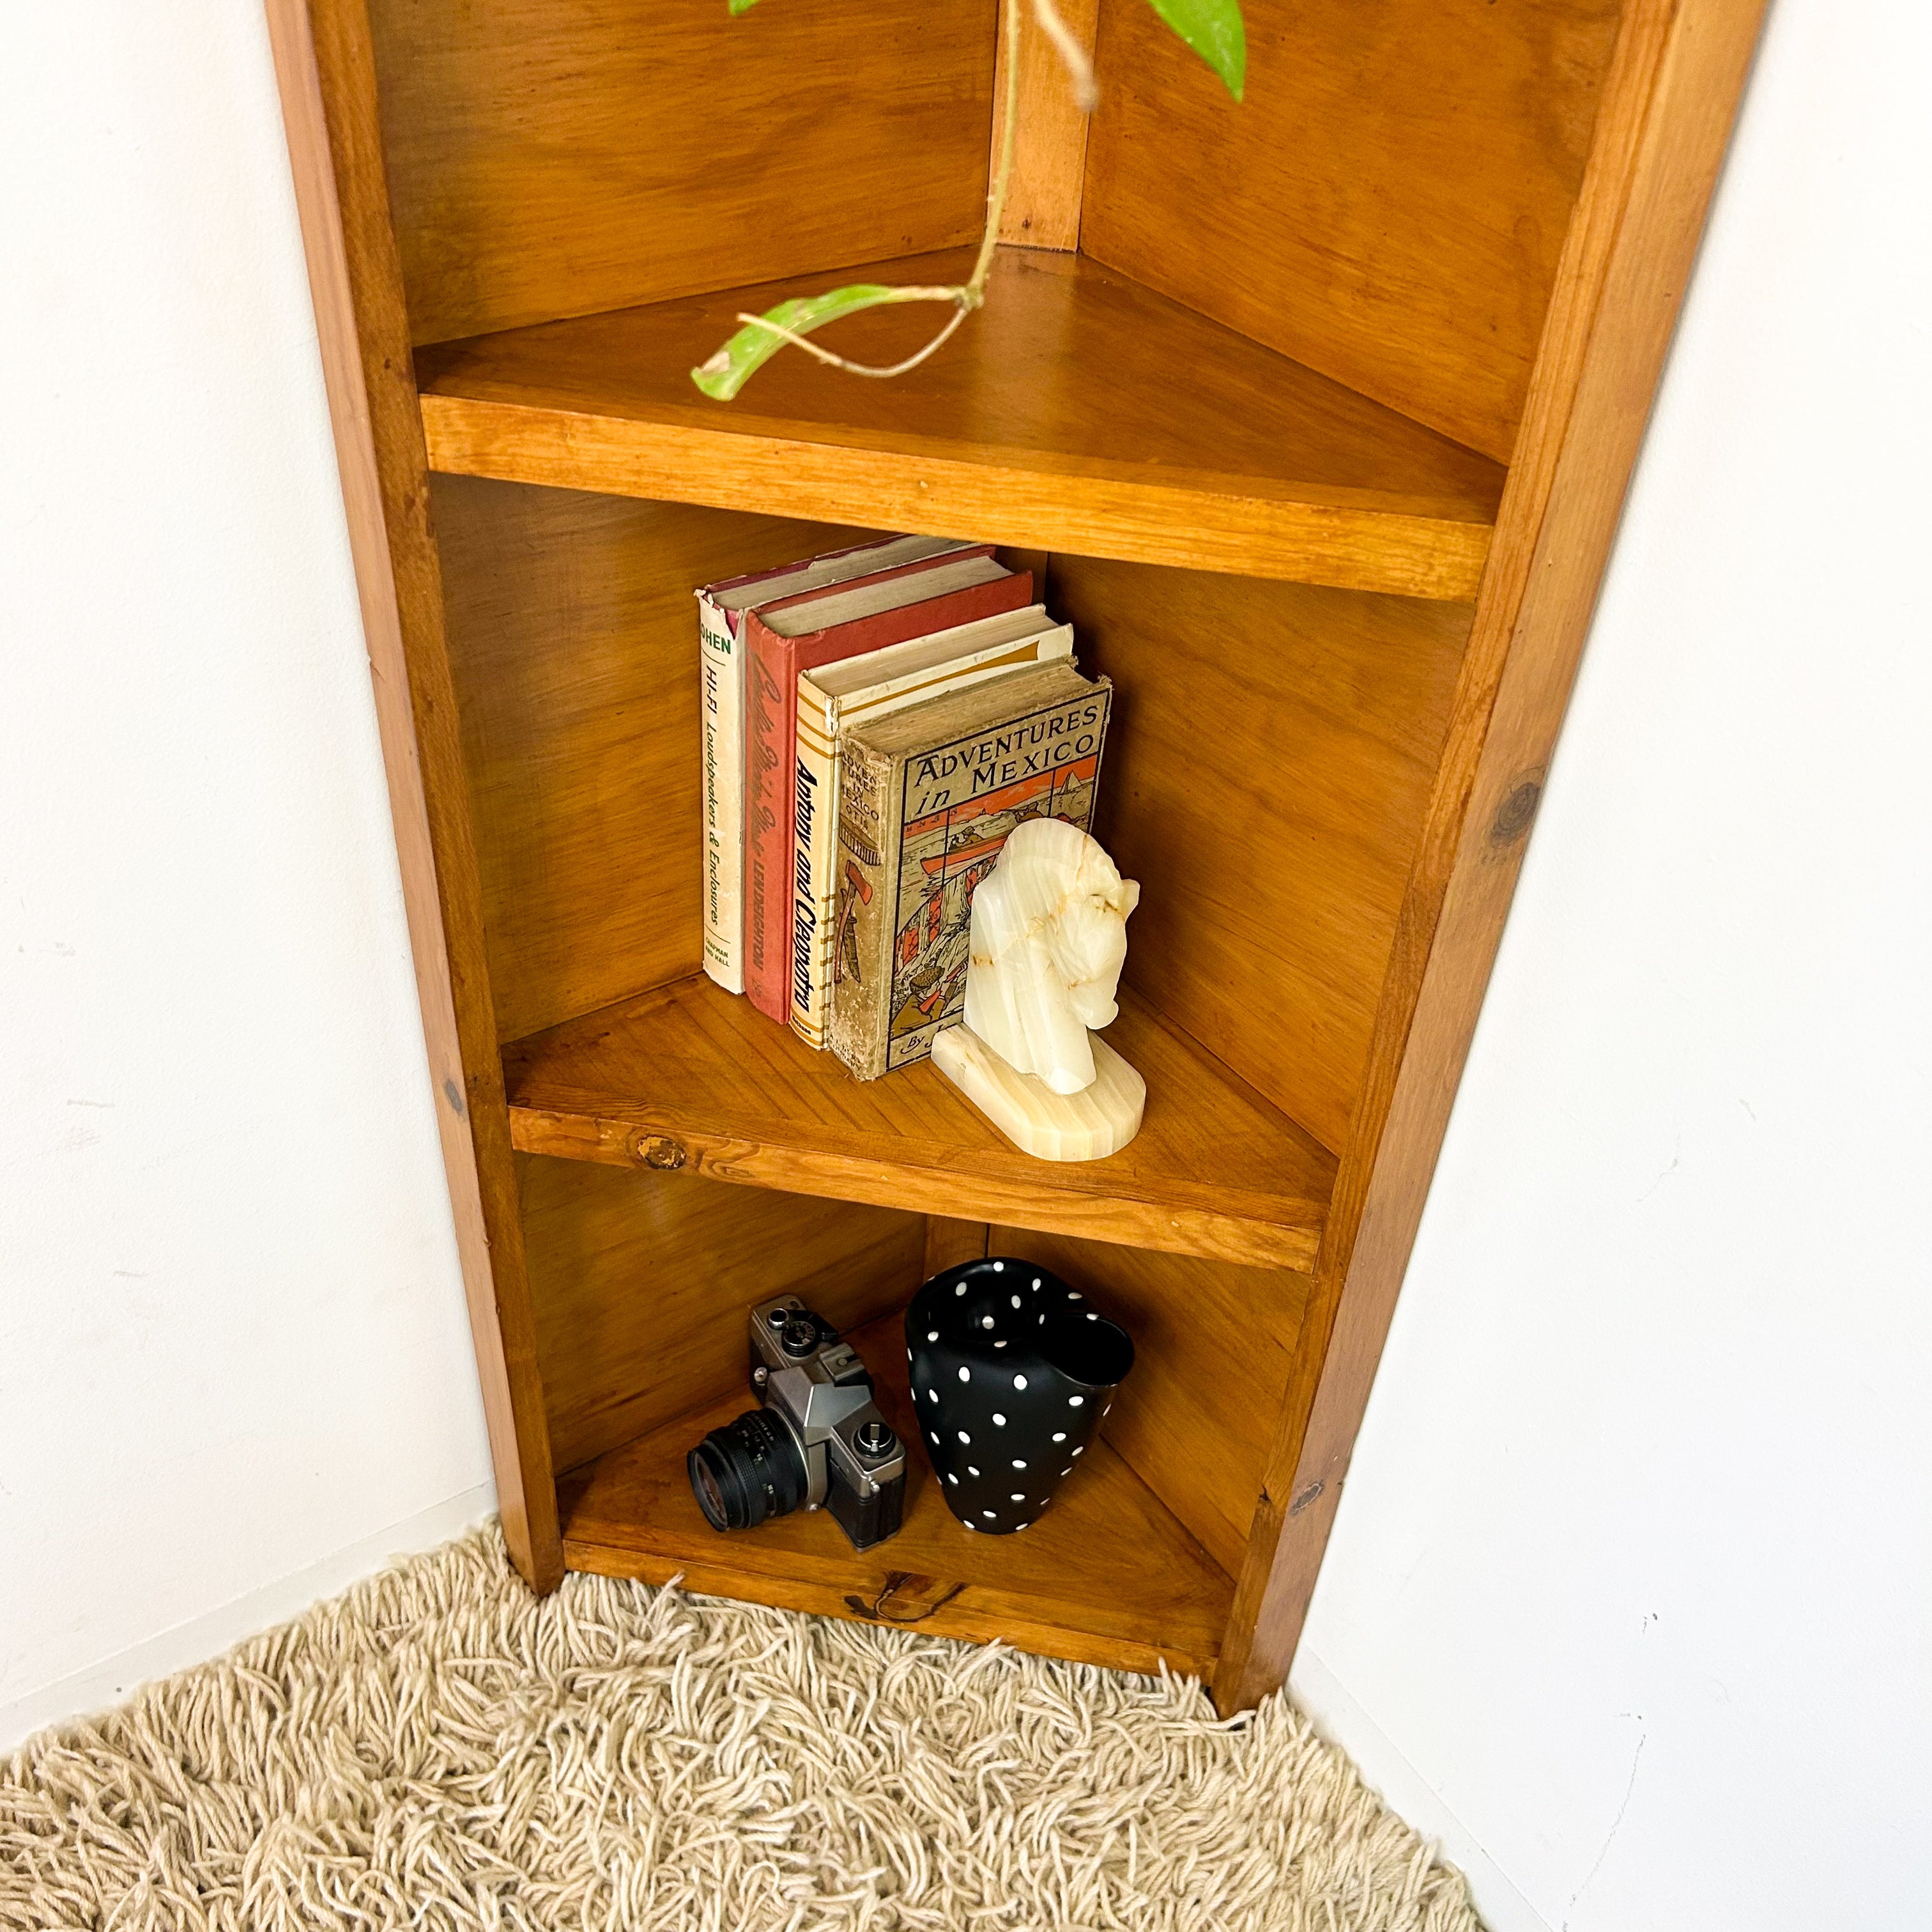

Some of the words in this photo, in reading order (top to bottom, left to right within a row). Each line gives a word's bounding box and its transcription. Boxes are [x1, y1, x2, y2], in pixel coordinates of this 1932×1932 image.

[706, 664, 717, 714] HI-FI
[706, 721, 719, 828] Loudspeakers
[914, 705, 1098, 788] ADVENTURES
[915, 788, 951, 816] in
[971, 734, 1094, 794] MEXICO
[795, 755, 818, 852] Antony
[846, 805, 868, 829] OTIS
[709, 831, 719, 848] &
[709, 849, 720, 926] Enclosures
[796, 848, 816, 905] and
[715, 954, 730, 967] HALL
[793, 898, 817, 1013] Cleopatra
[900, 1036, 926, 1054] By
